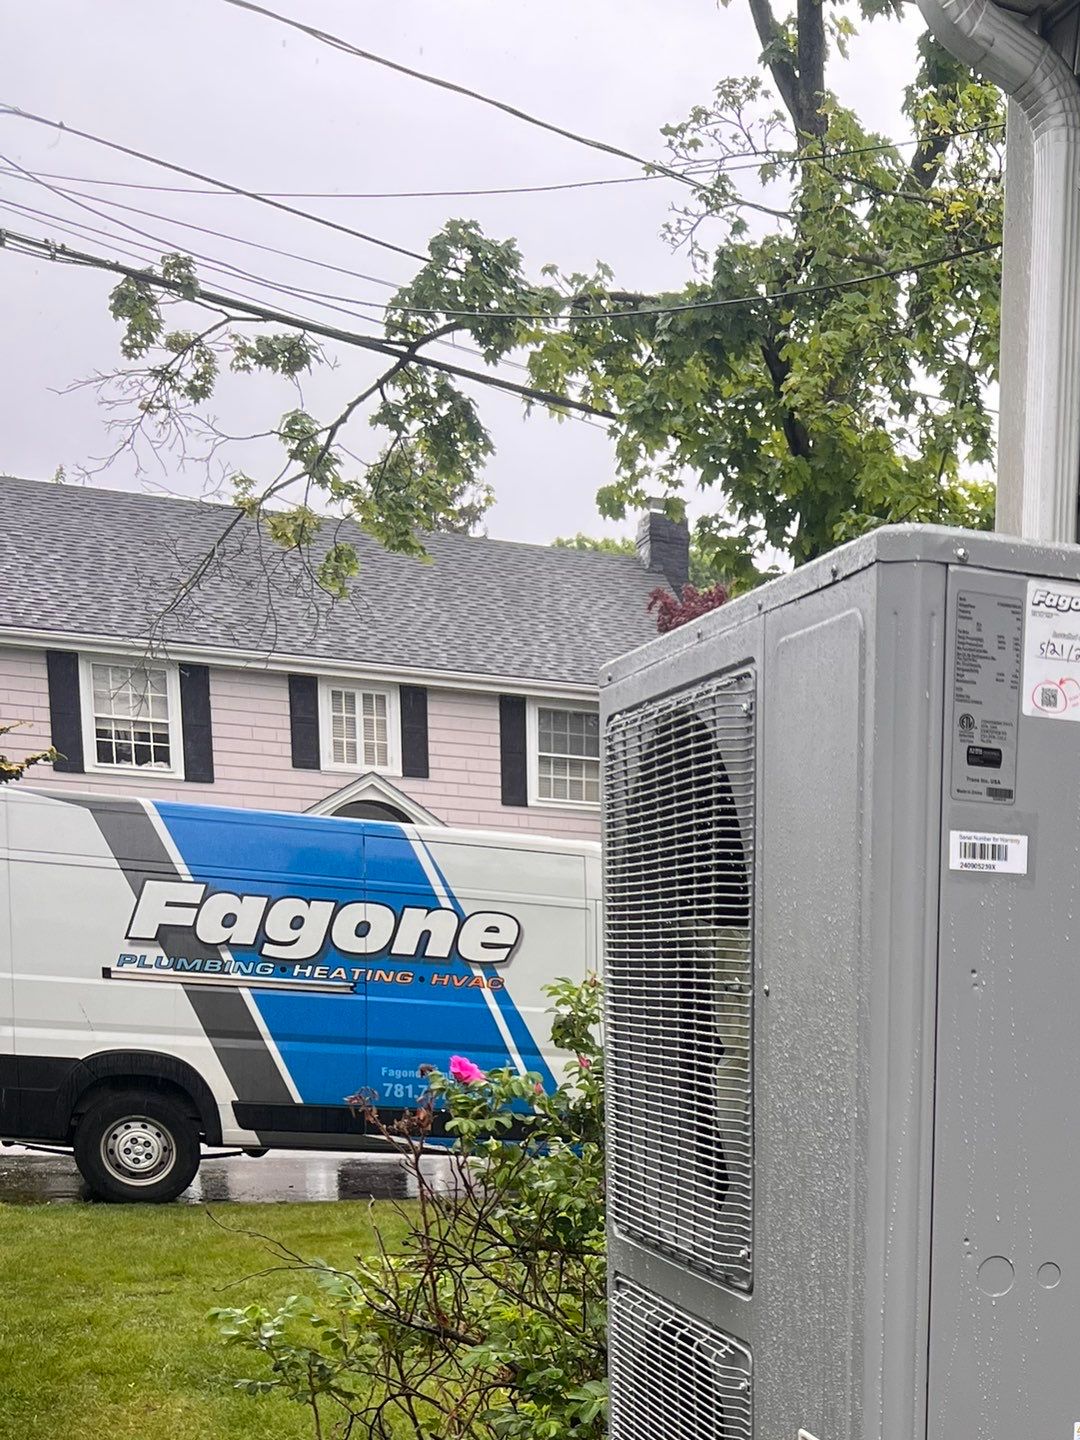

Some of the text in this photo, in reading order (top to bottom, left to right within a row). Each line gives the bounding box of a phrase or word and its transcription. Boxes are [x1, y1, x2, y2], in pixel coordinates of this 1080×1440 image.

[124, 879, 522, 964] Fagone
[116, 953, 506, 991] PLUMBING HEATING HVAC
